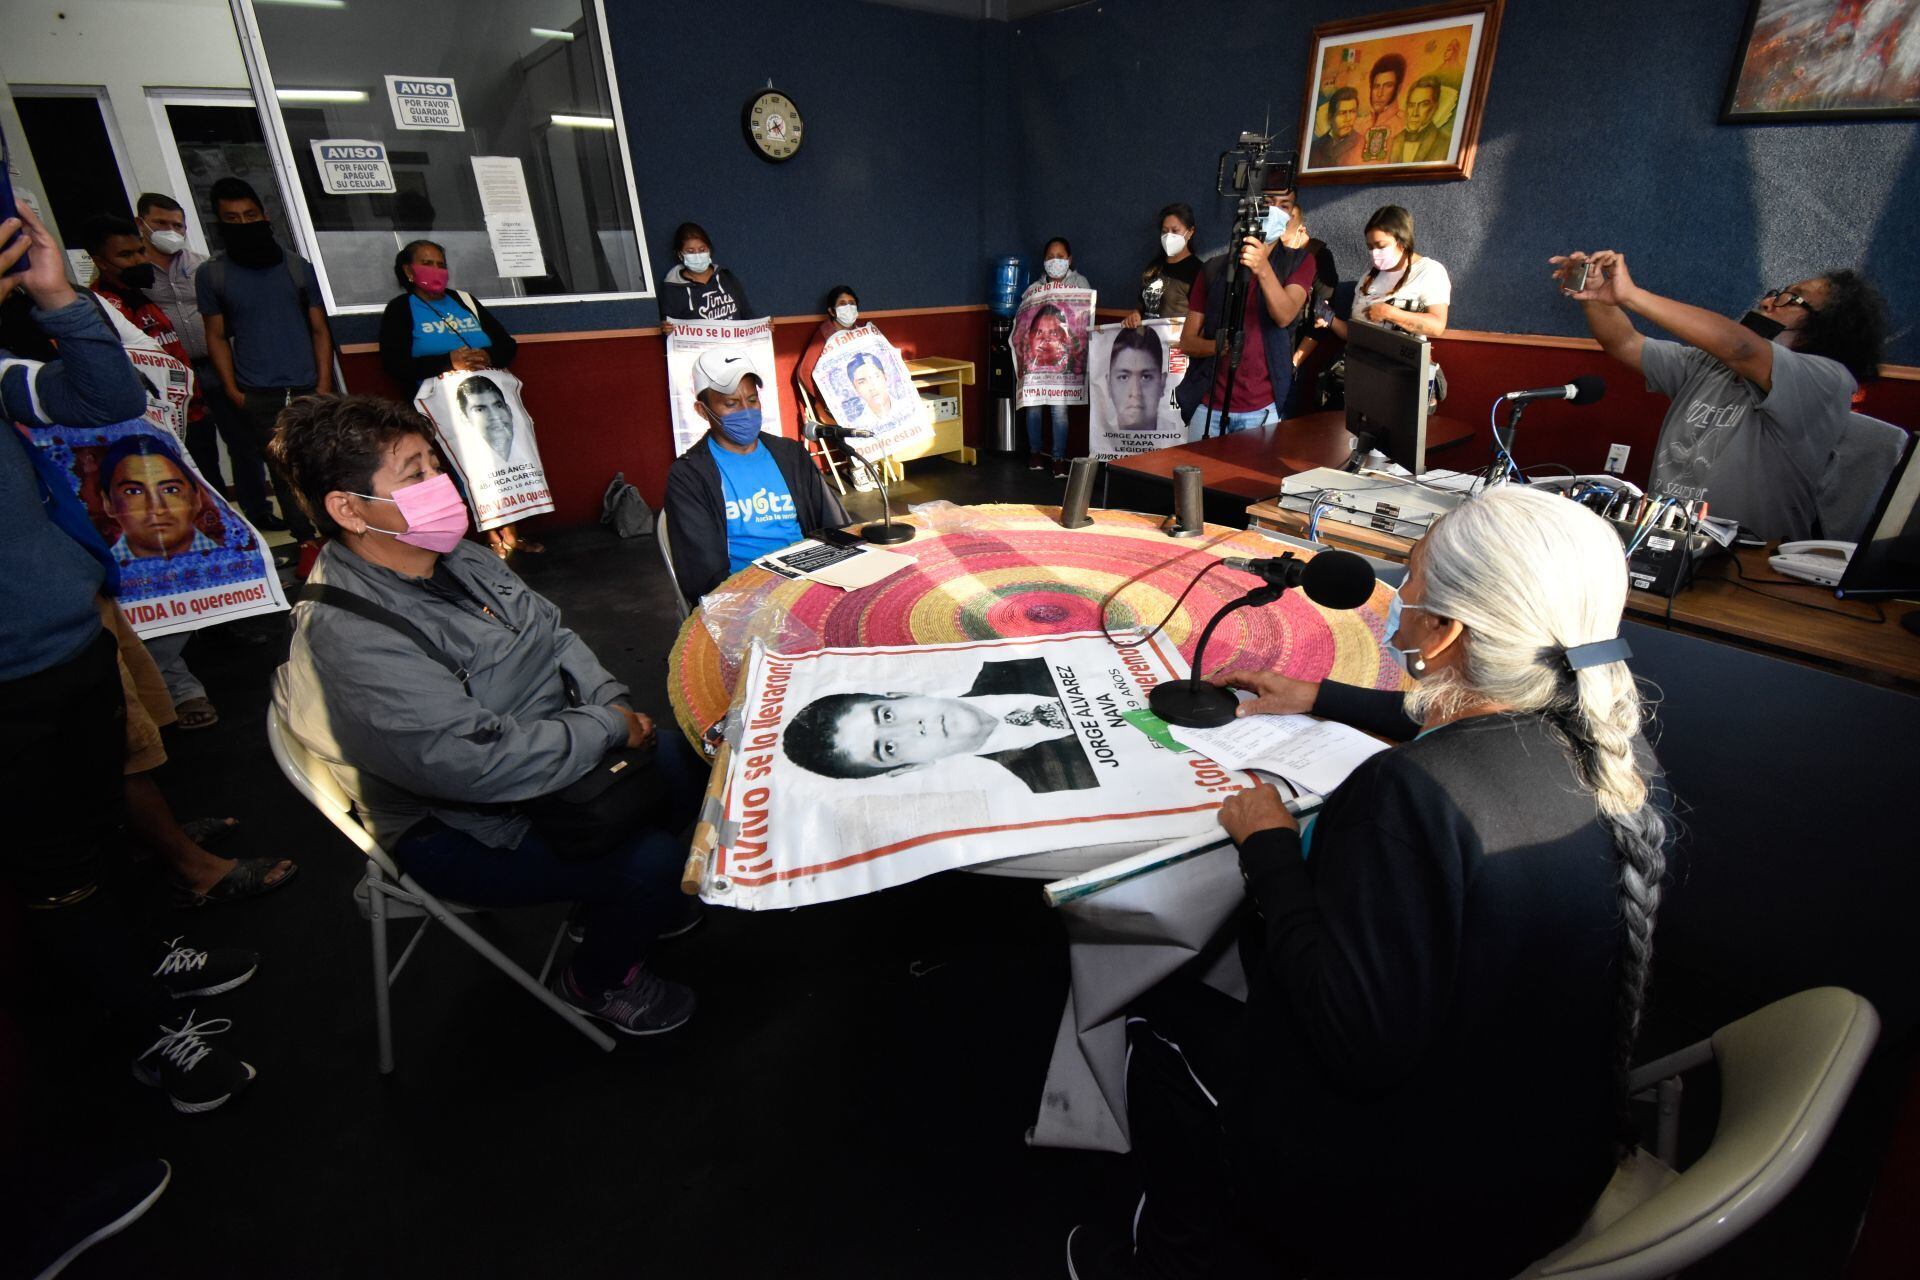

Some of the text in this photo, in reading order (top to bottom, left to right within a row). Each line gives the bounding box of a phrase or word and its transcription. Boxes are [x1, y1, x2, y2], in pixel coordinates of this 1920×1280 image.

[401, 83, 448, 95] AVISO
[405, 99, 450, 109] POR FAVOR
[409, 107, 448, 116] GUARDAR
[412, 115, 450, 124] SILENCIO
[327, 147, 379, 159] AVISO
[334, 163, 380, 172] POR FAVOR
[343, 172, 375, 180] APAGUE
[336, 180, 386, 188] SU CELULAR
[701, 290, 734, 312] Times
[698, 303, 738, 320] Square
[673, 324, 703, 337] ¡Vivo
[706, 328, 718, 337] se
[721, 327, 731, 338] lo
[820, 344, 834, 355] os
[834, 326, 870, 345] faltan
[1133, 432, 1182, 440] ANTONIO
[517, 493, 526, 504] lo
[123, 602, 169, 625] VIDA
[170, 600, 187, 617] lo
[189, 583, 267, 615] queremos!
[1108, 668, 1134, 697] AÑOS
[1056, 665, 1120, 768] JORGE ÁLVAREZ
[1096, 693, 1128, 728] NAVA
[733, 659, 794, 874] ¡Vivo se lo llevaron!
